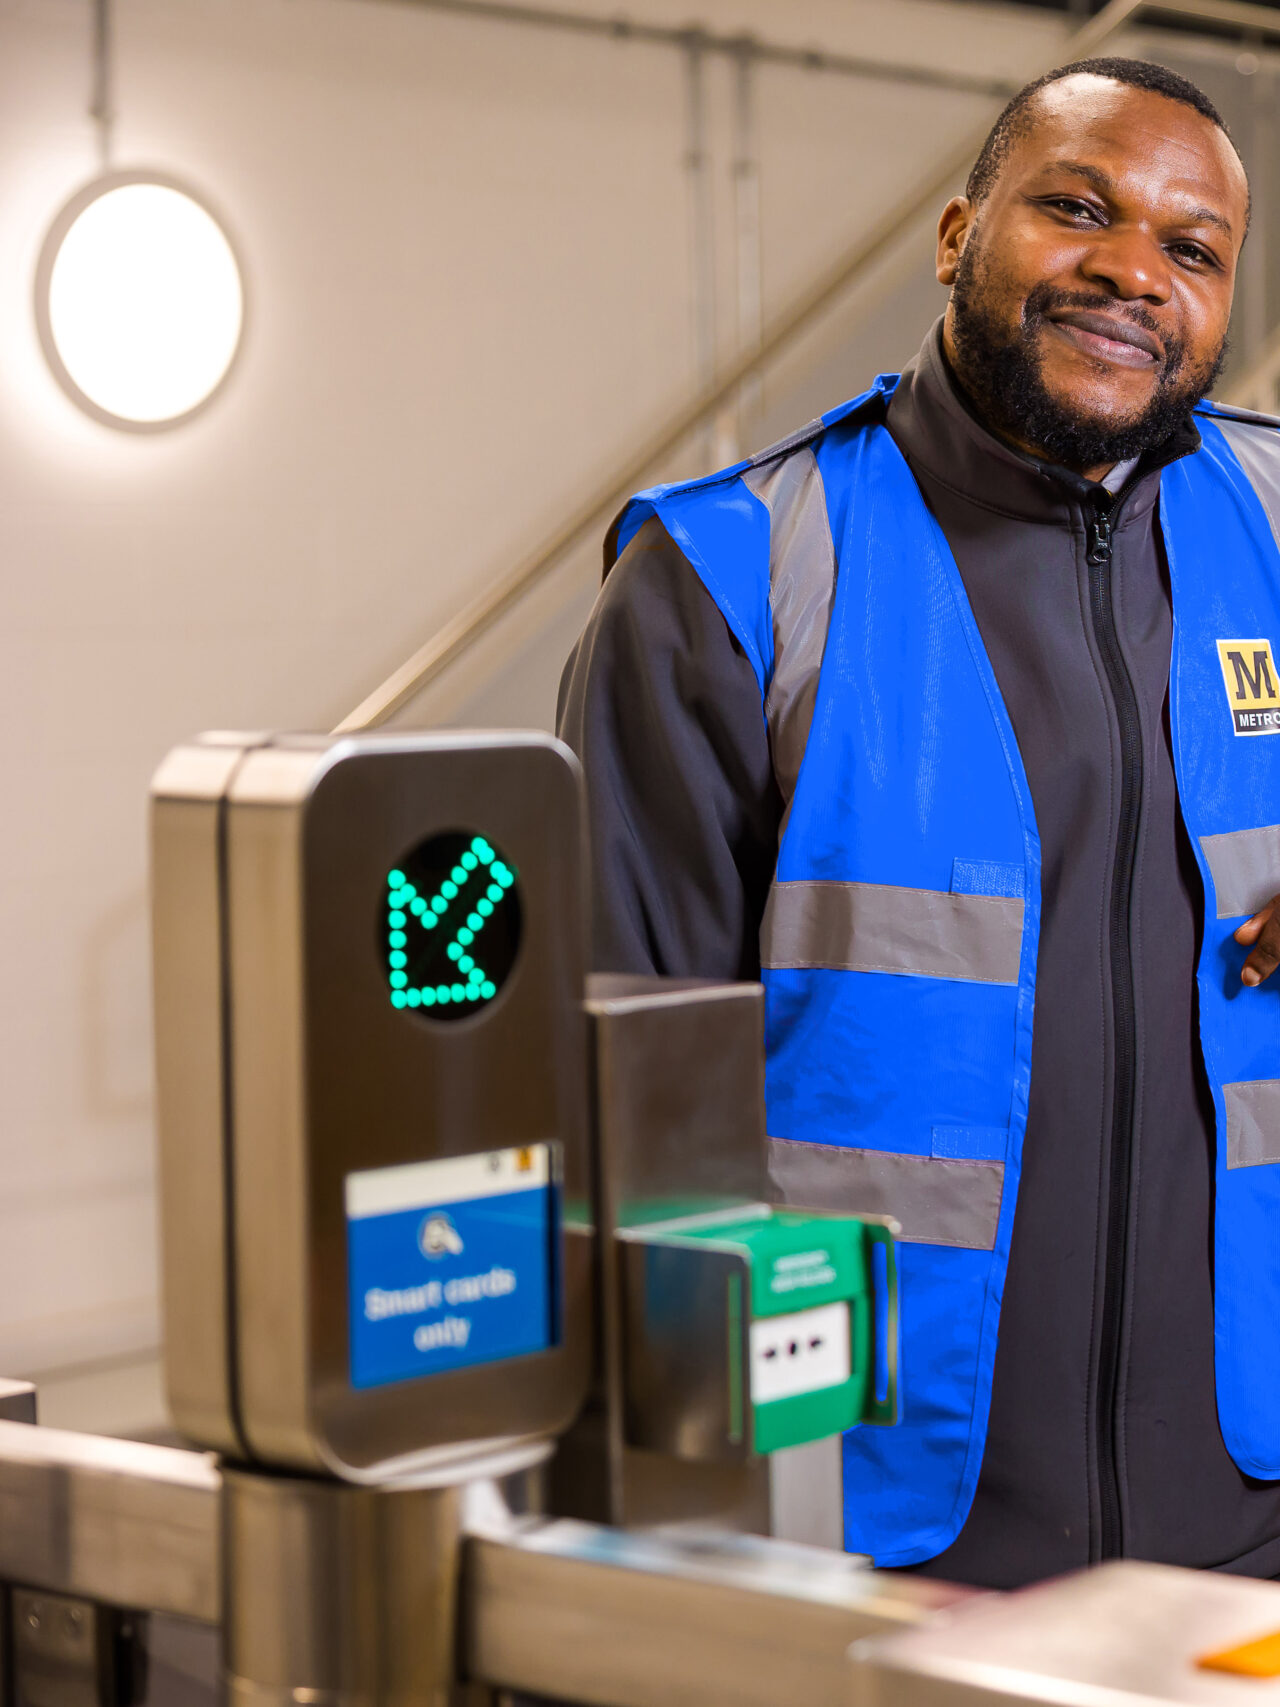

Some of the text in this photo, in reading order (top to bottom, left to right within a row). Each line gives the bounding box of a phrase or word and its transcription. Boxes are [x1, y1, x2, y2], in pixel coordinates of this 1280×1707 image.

[1227, 651, 1276, 700] M
[364, 1266, 517, 1322] Smart cards
[413, 1315, 472, 1352] only
